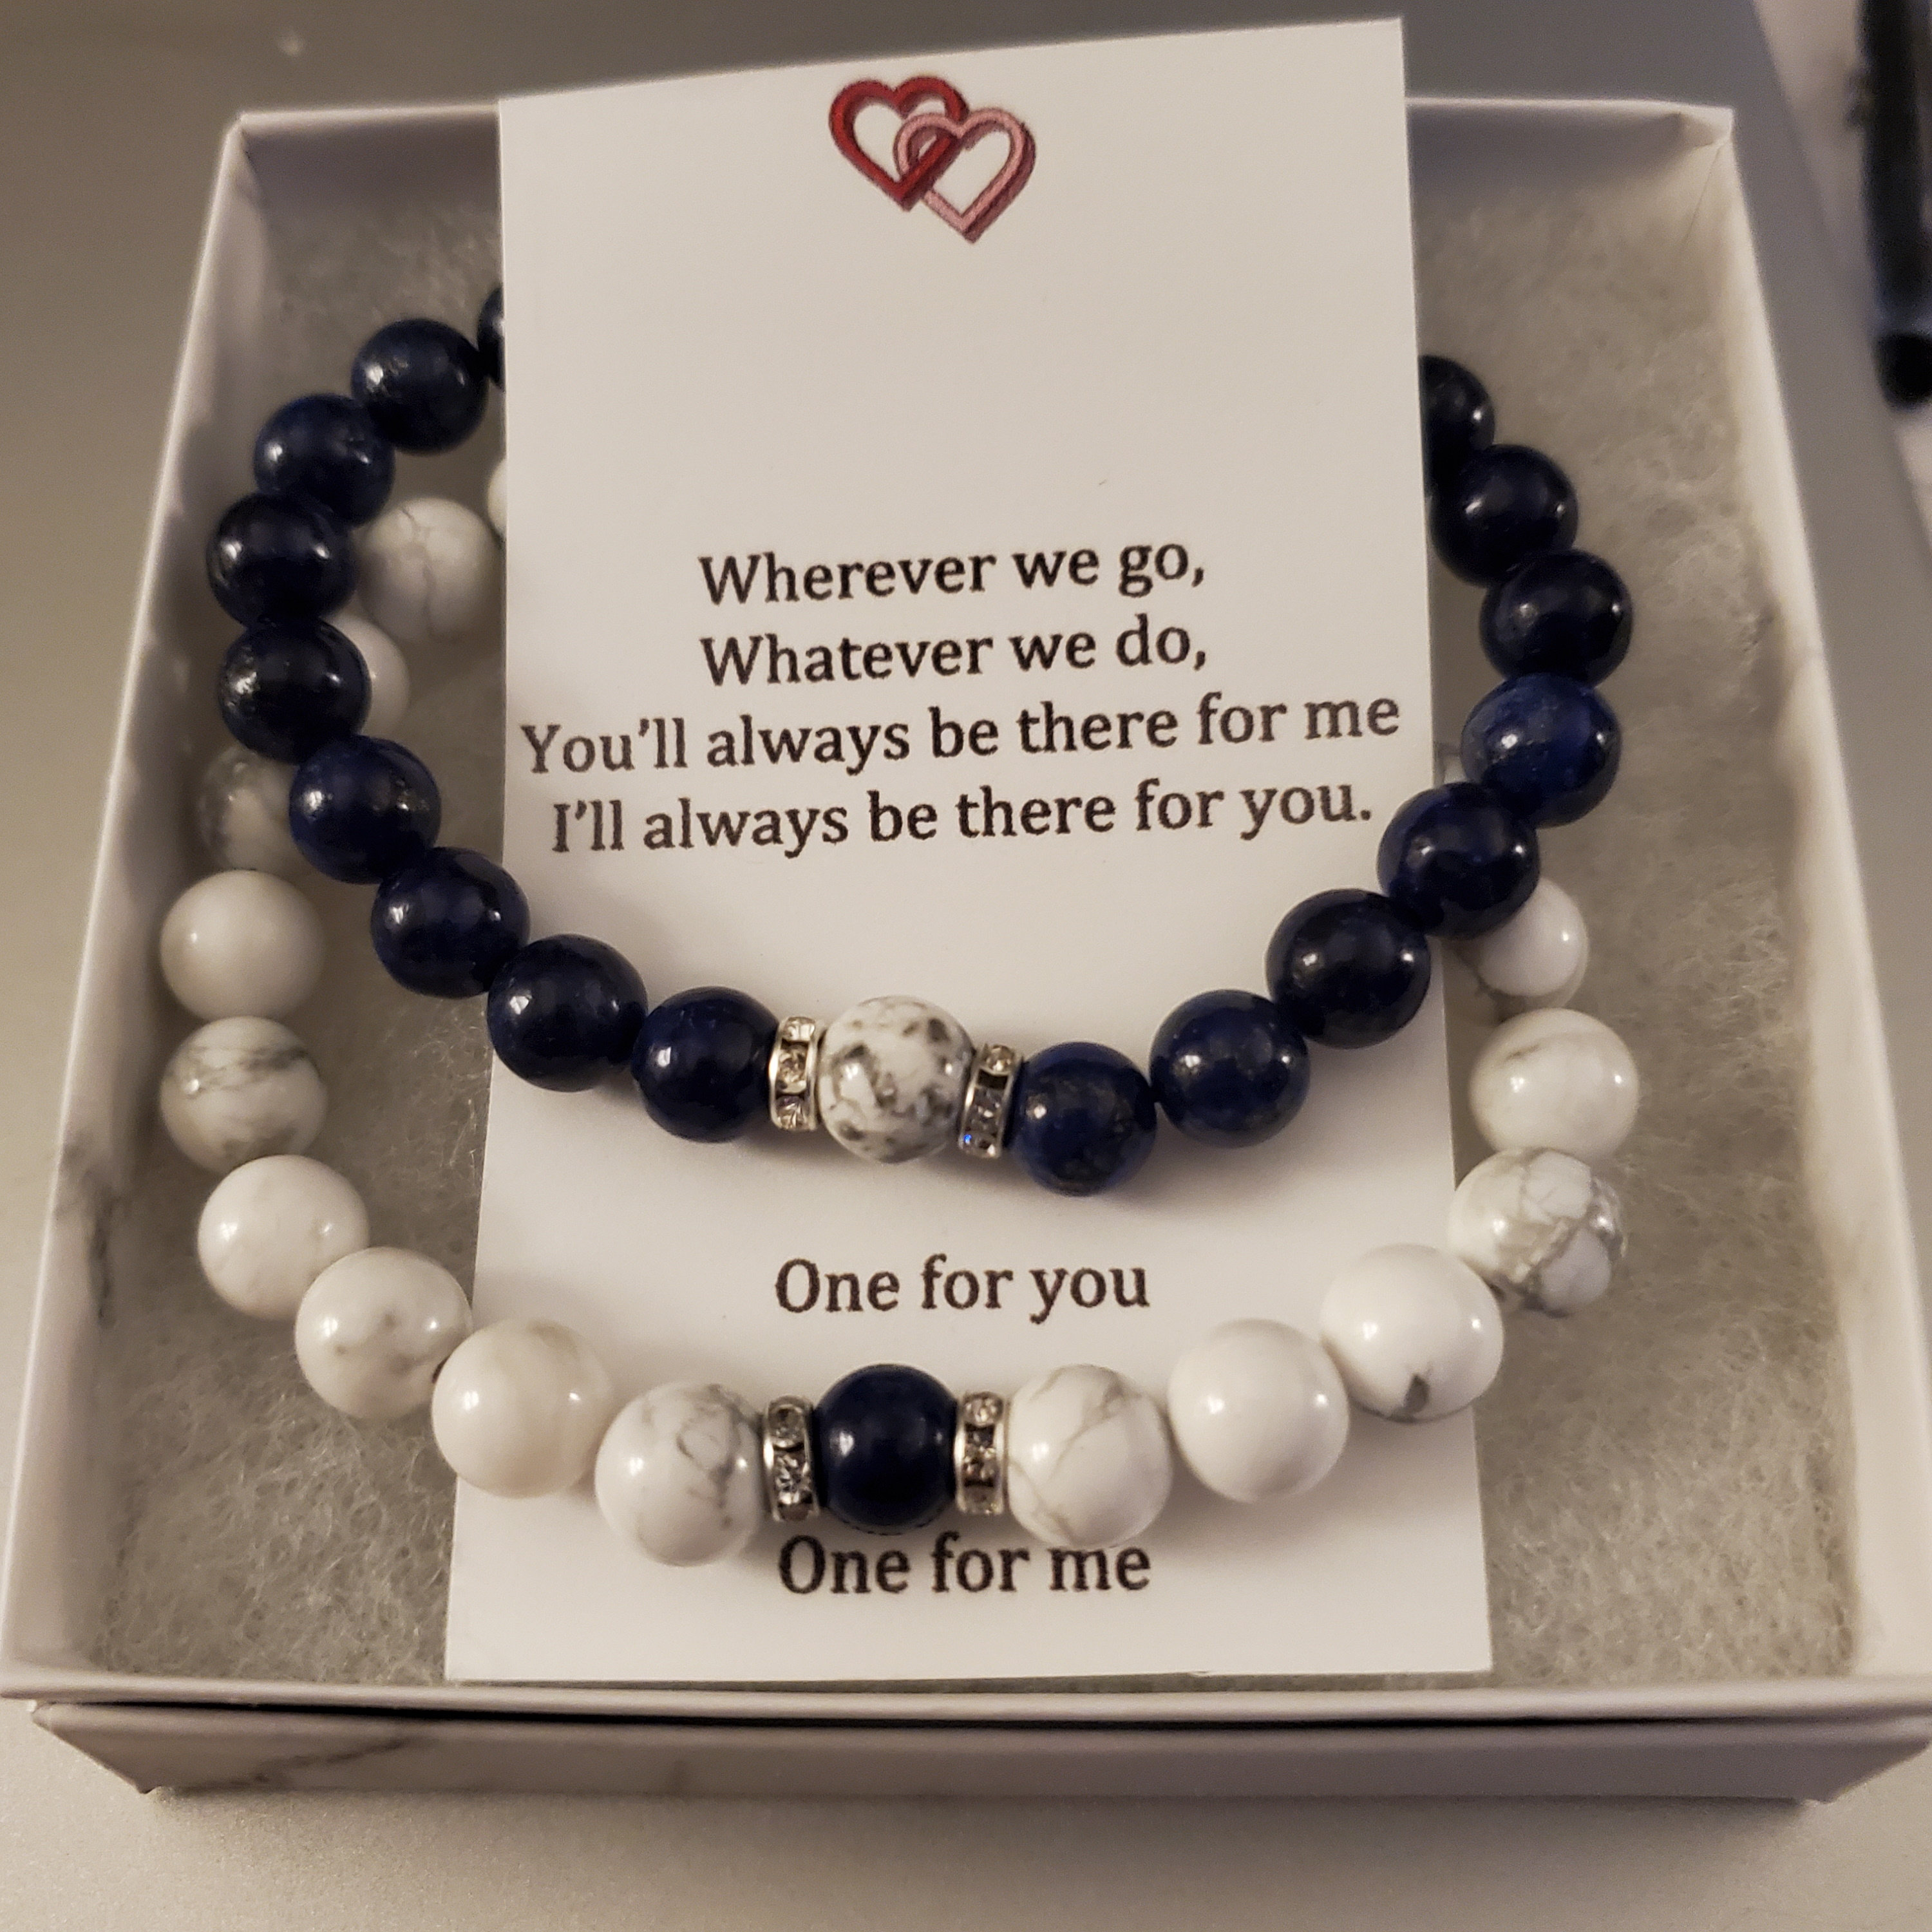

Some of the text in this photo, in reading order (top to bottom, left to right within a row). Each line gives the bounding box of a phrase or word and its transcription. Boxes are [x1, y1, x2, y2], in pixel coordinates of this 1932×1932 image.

[697, 544, 1204, 605] Wherever we go,
[699, 612, 1206, 687] Whatever we do,
[707, 714, 909, 776] always
[927, 706, 999, 758] be
[1016, 701, 1178, 754] there
[1197, 691, 1288, 745] for
[1304, 698, 1399, 740] me
[643, 797, 848, 859] always
[866, 790, 938, 842] be
[954, 785, 1116, 838] there
[1135, 777, 1225, 831] for
[1238, 784, 1372, 840] you.
[775, 1253, 1150, 1325] One for you
[778, 1531, 1151, 1595] One for me
